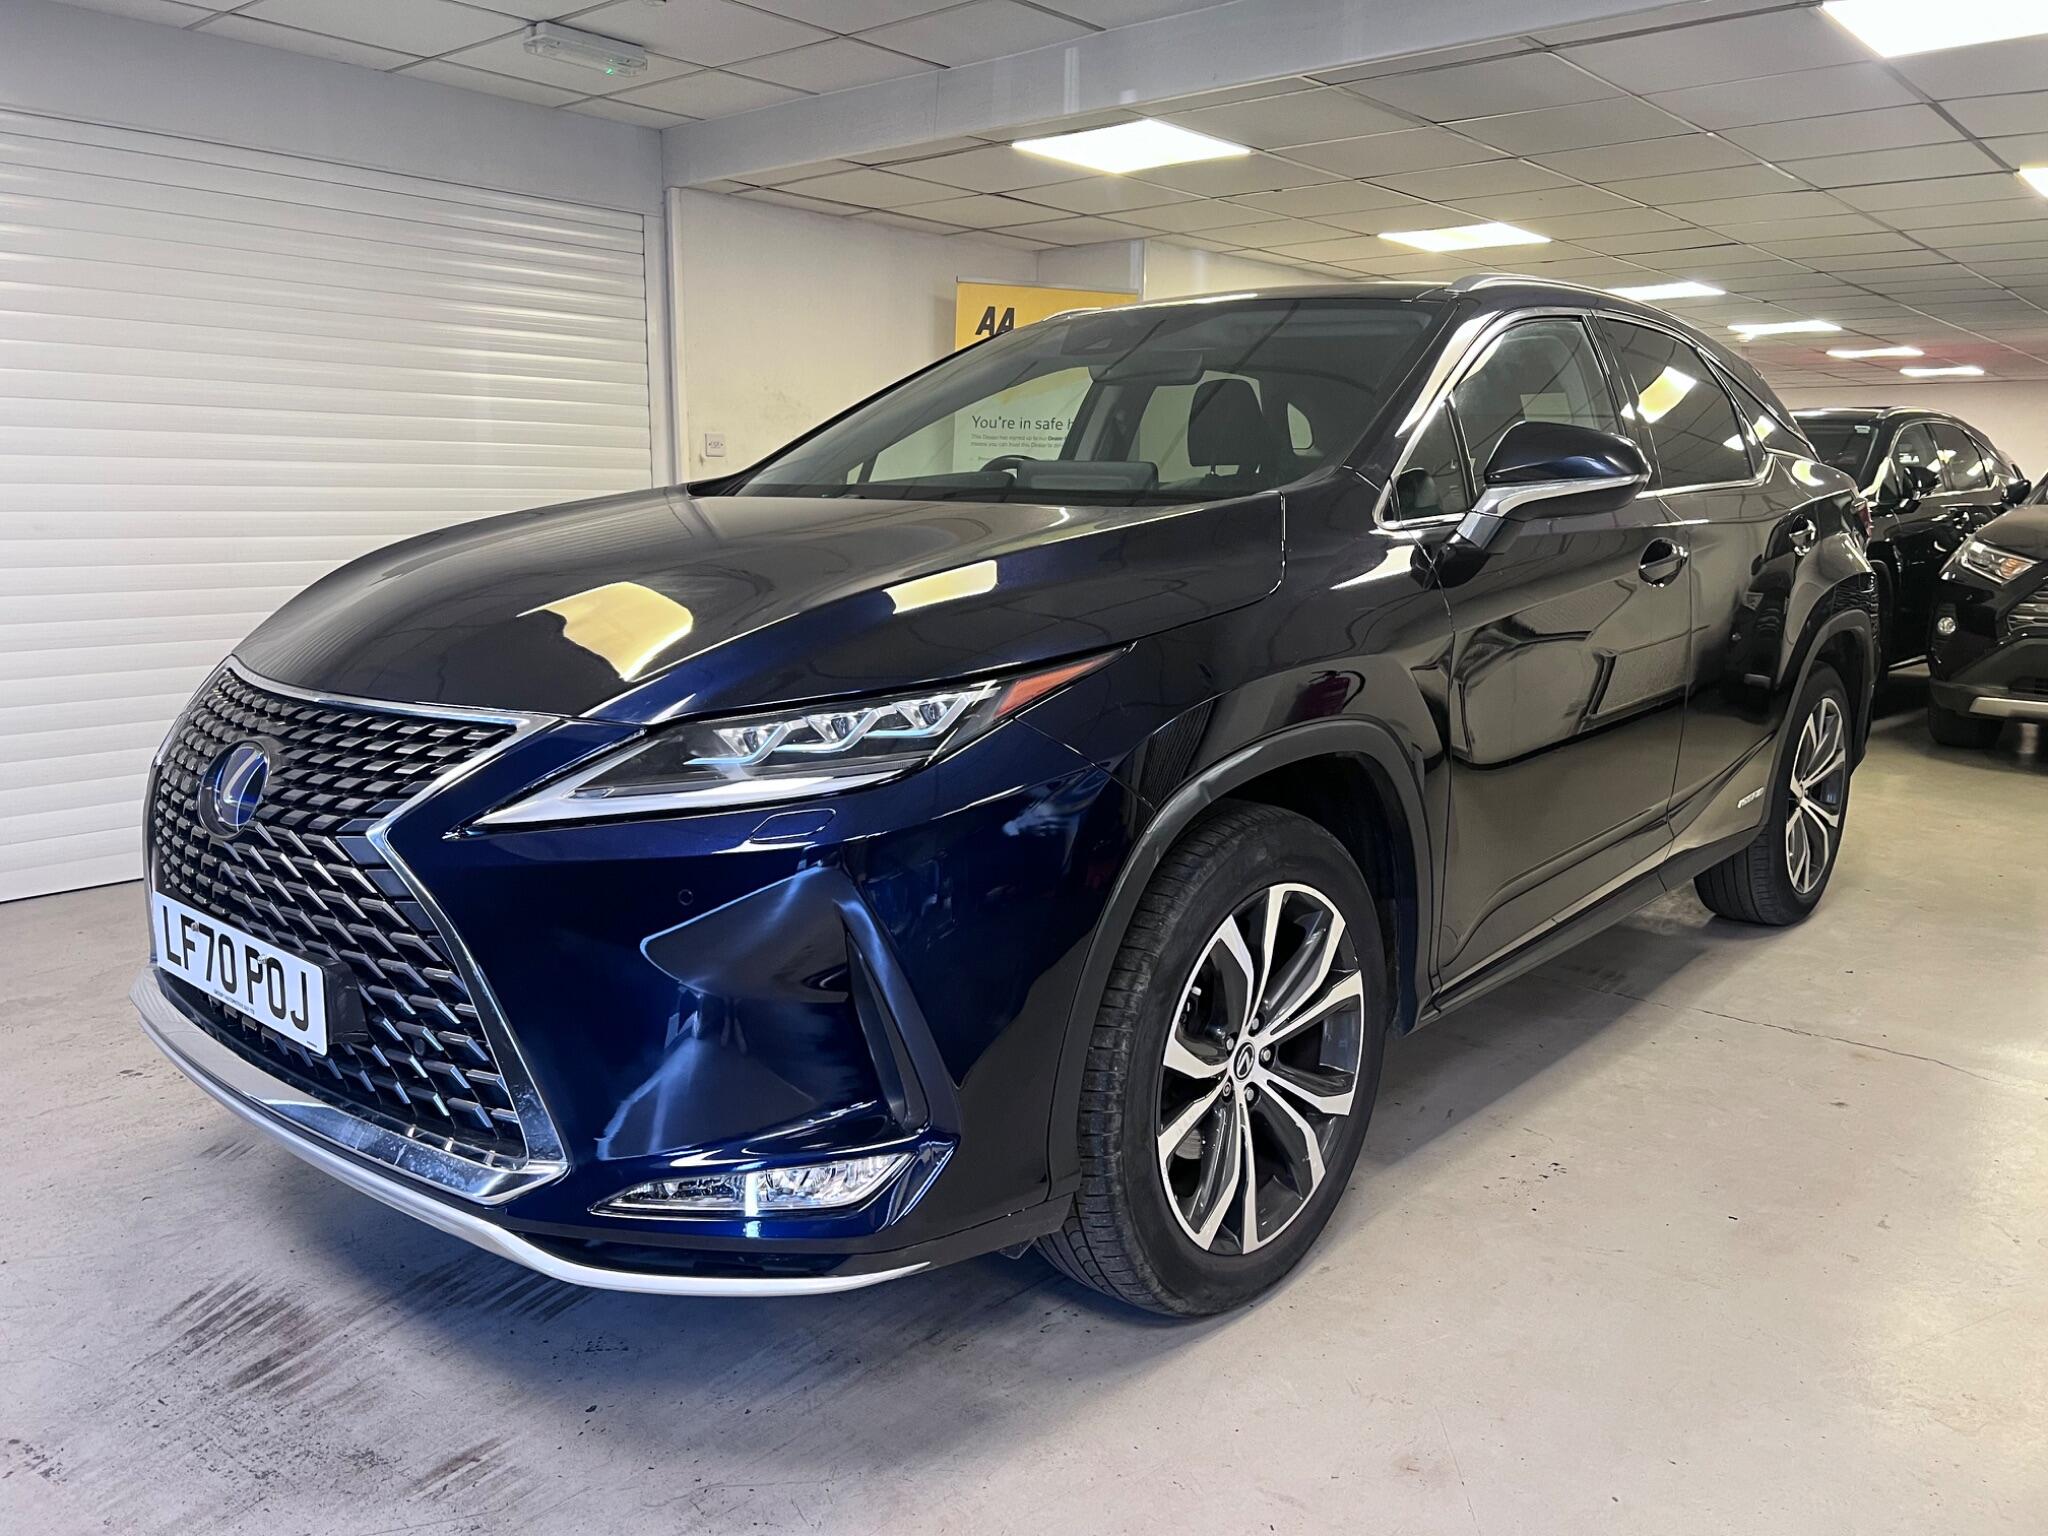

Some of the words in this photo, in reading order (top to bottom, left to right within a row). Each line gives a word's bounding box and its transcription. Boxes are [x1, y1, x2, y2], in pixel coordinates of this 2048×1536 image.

[975, 306, 1015, 336] AA
[972, 415, 1015, 429] You're
[1020, 416, 1031, 430] in
[1035, 417, 1063, 431] safe
[163, 905, 237, 994] LF70
[245, 944, 309, 1032] POJ
